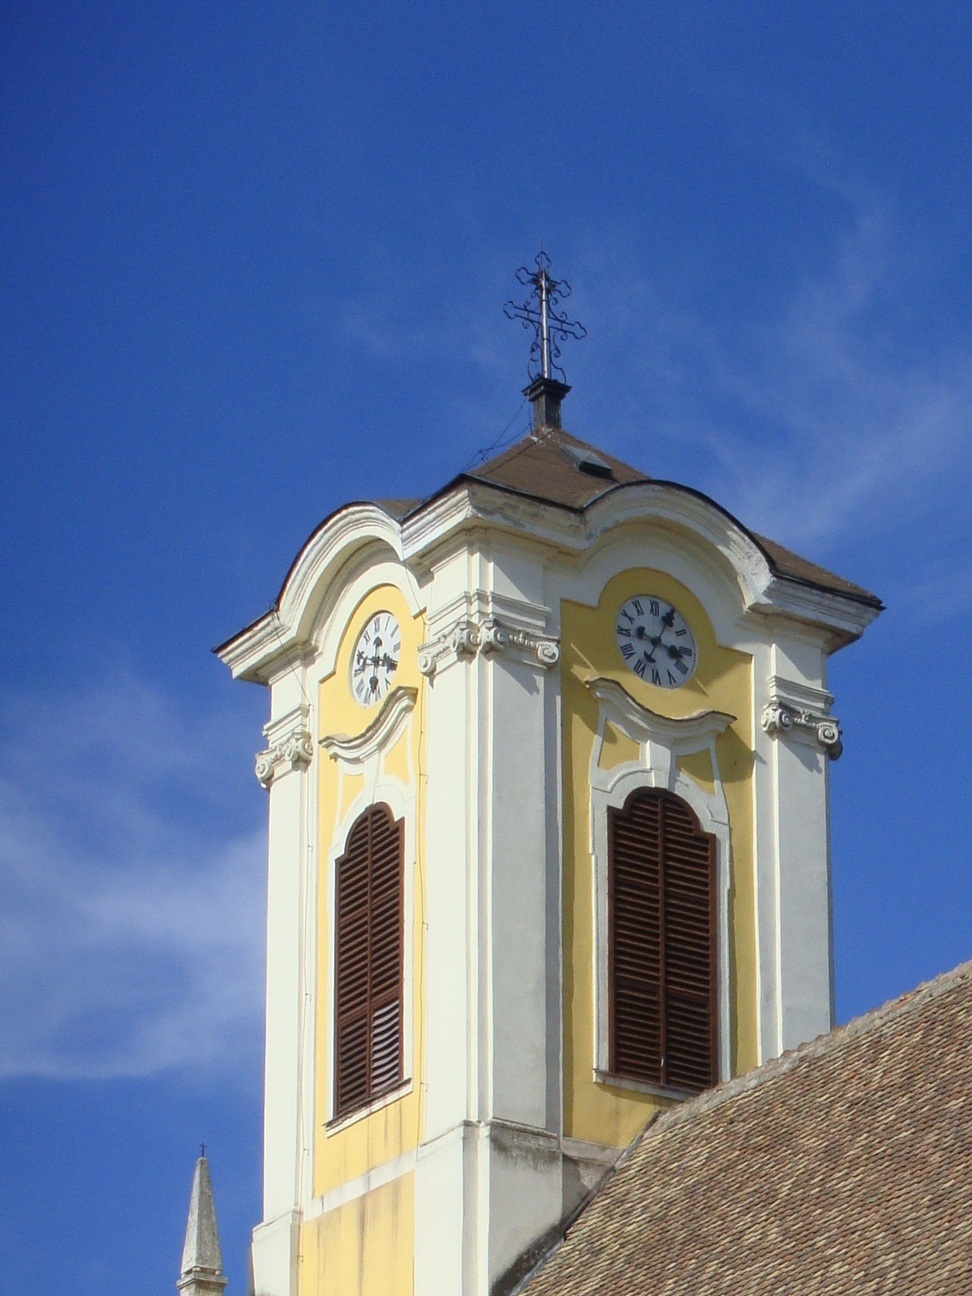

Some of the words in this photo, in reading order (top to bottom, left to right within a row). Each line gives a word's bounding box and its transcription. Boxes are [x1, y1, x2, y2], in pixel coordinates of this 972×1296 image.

[632, 600, 644, 616] XI
[621, 610, 635, 624] X
[617, 625, 631, 638] IX
[675, 628, 688, 637] II
[620, 643, 636, 660] VIII
[633, 660, 646, 678] VII
[652, 668, 662, 686] VI
[667, 669, 676, 685] V
